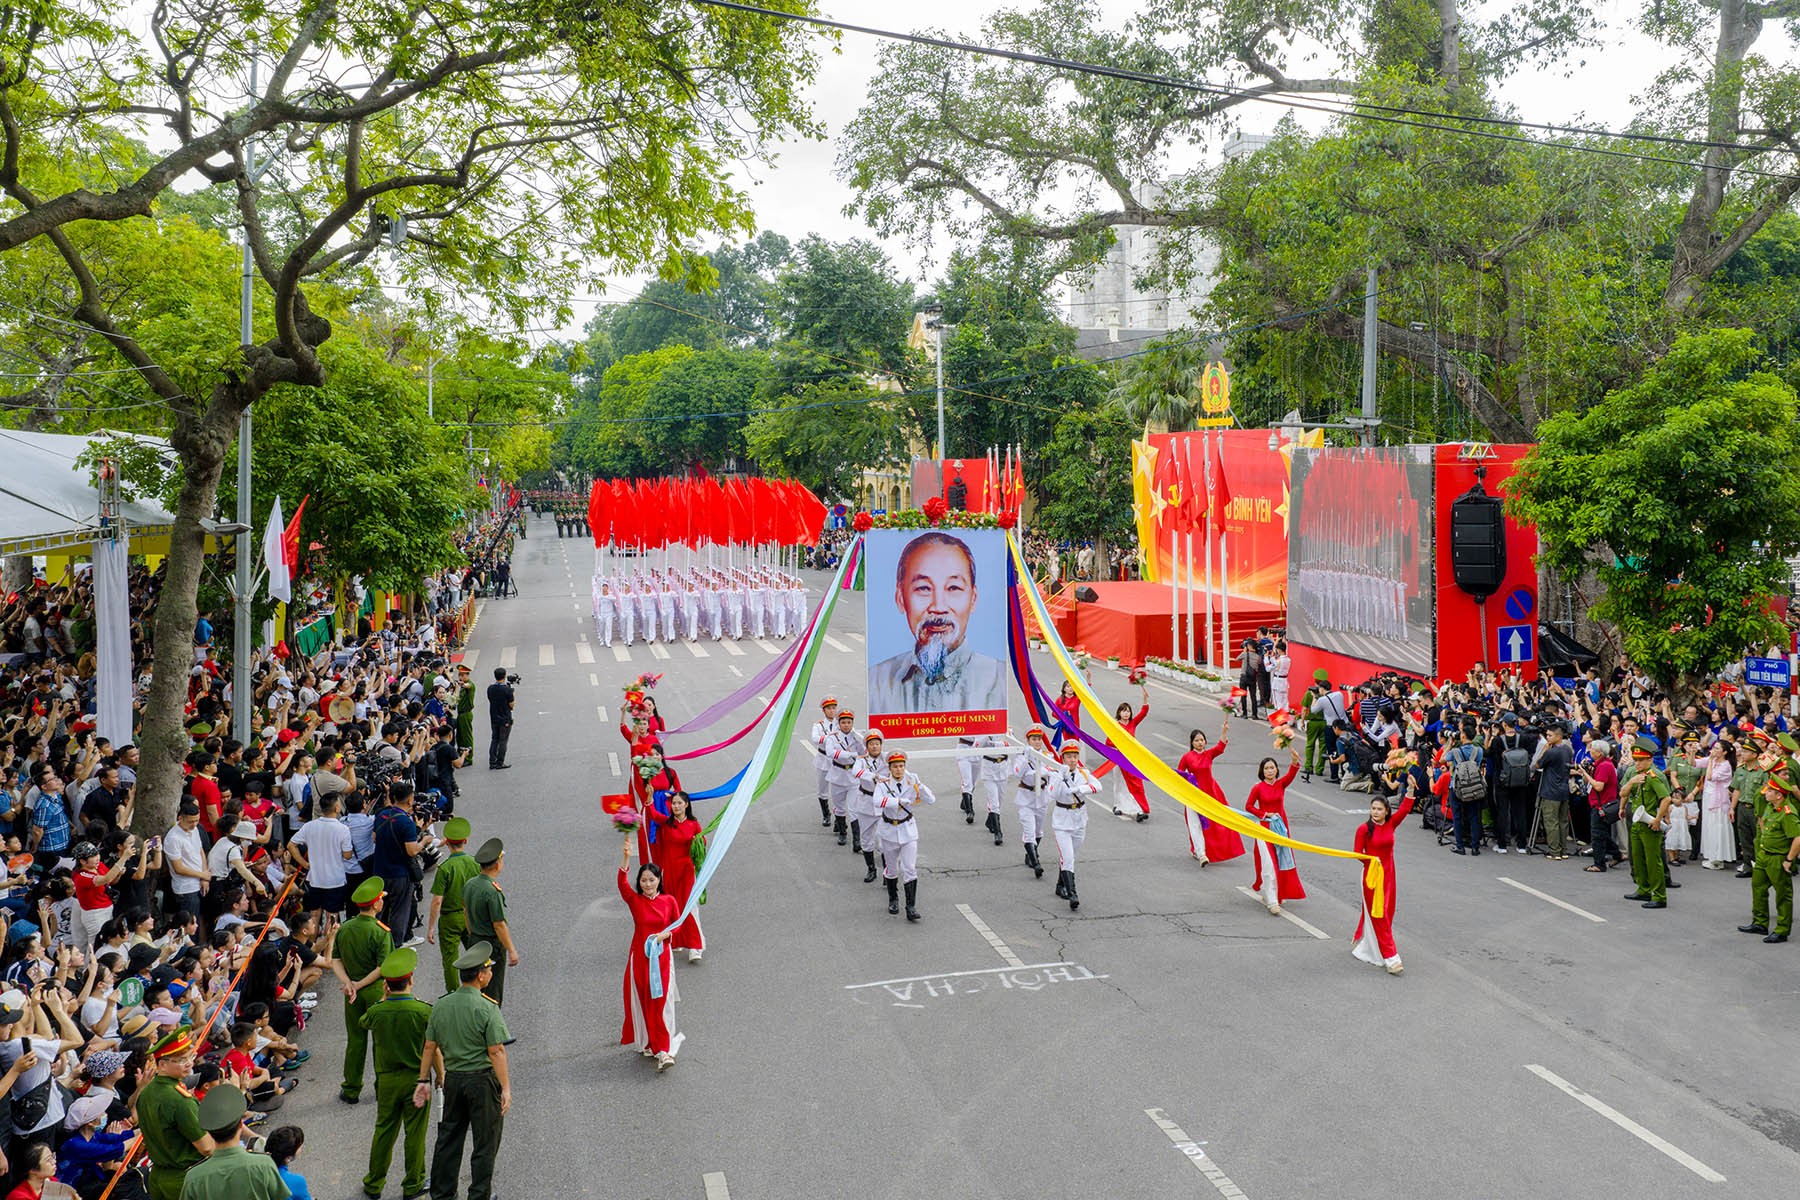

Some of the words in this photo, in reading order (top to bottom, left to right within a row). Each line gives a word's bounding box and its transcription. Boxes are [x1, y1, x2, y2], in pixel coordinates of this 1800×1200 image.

[1233, 494, 1253, 522] BÌNH
[1255, 495, 1272, 524] YÊN
[880, 716, 903, 727] CHỦ
[904, 716, 929, 727] TỊCH
[931, 714, 947, 725] HỒ
[948, 714, 967, 725] CHÍ
[969, 714, 996, 723] MINH
[912, 727, 935, 737] (1890
[943, 726, 966, 736] 1969)
